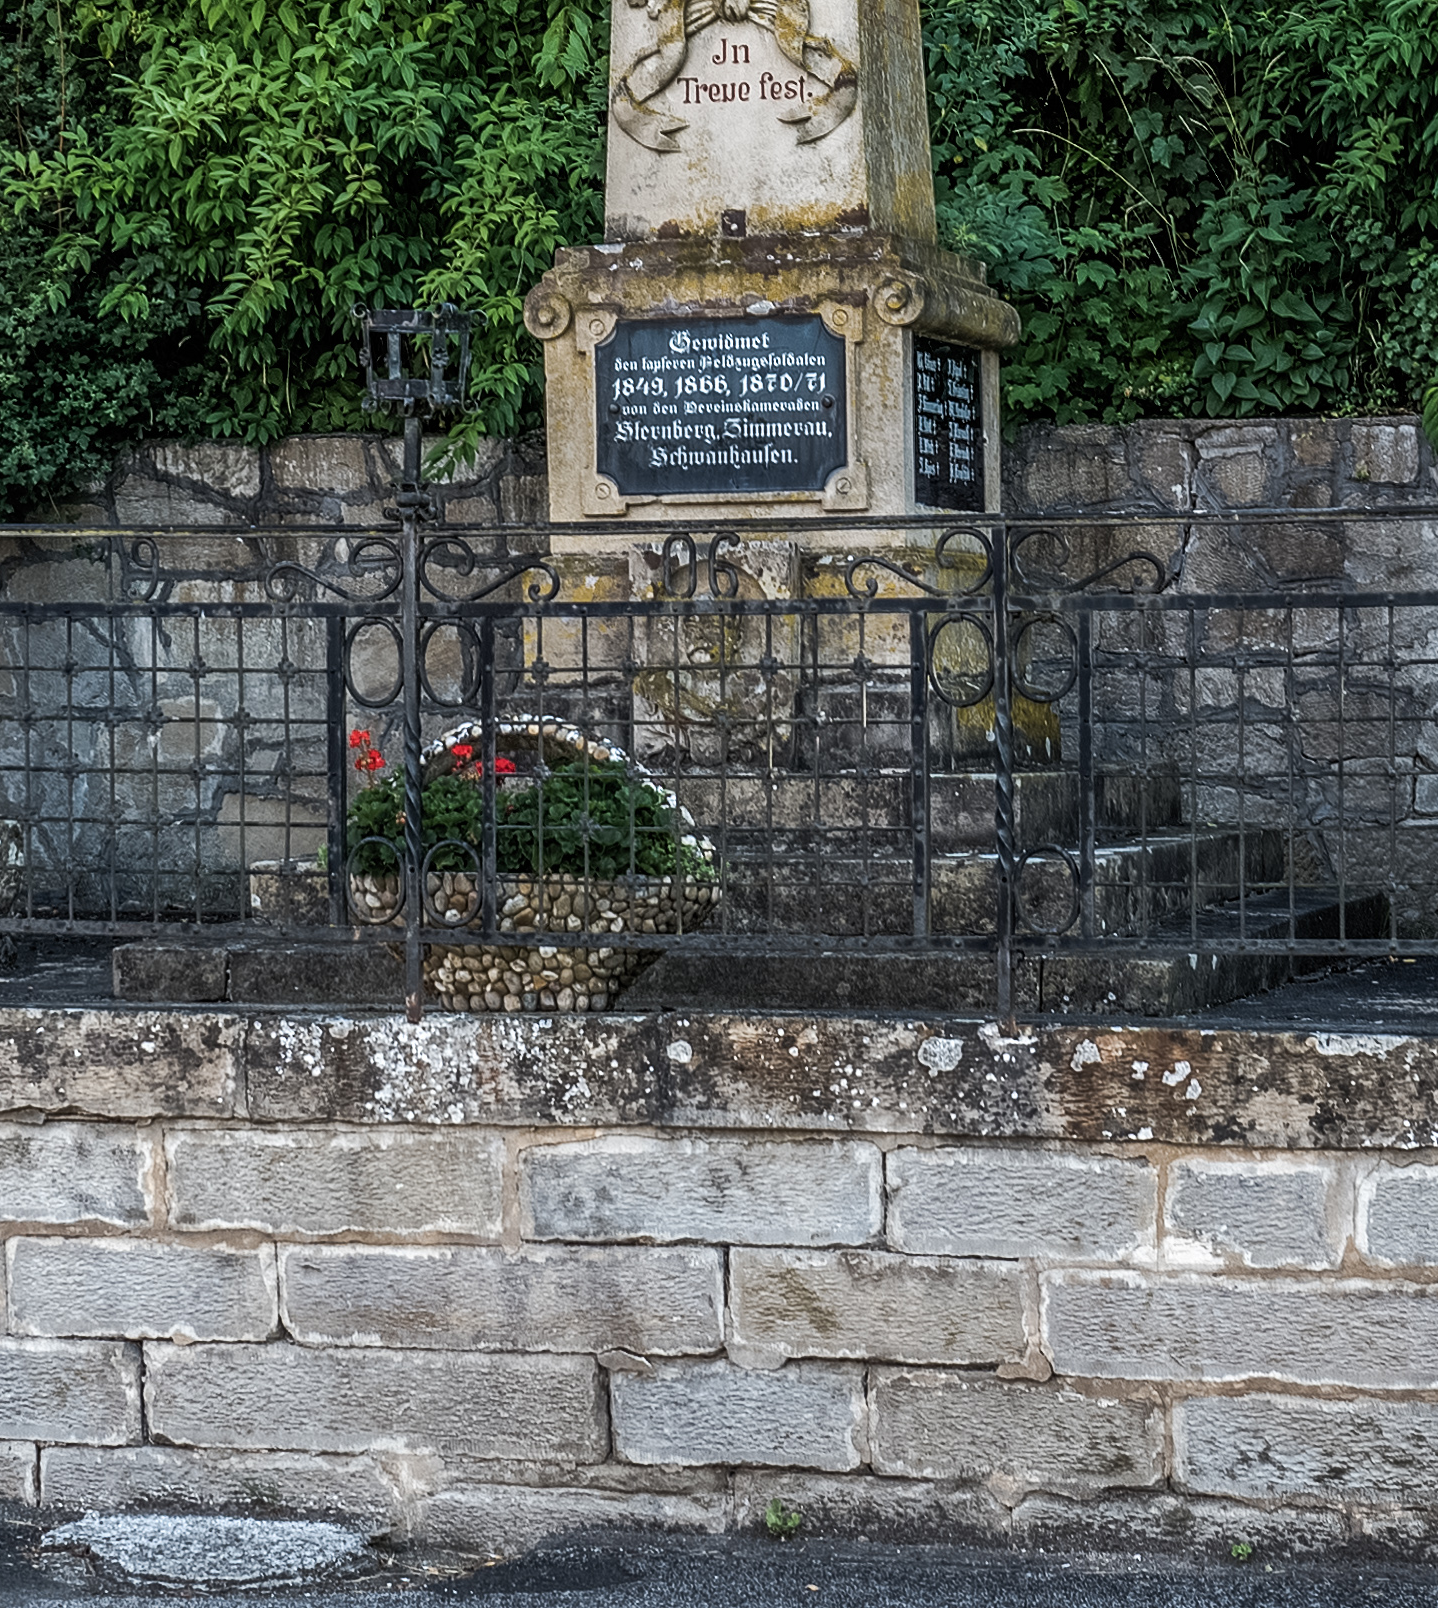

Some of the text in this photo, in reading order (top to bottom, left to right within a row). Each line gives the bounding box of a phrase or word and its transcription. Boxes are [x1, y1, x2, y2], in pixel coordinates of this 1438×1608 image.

[677, 72, 813, 104] Treue fest.
[669, 330, 770, 354] Gewidmet
[614, 357, 637, 372] den
[642, 355, 695, 374] tapferen
[612, 372, 827, 400] 1849, 1866, 1870/71
[622, 399, 819, 416] von den Vereinskameraden
[722, 417, 833, 439] Zimmerau,
[648, 444, 798, 469] Schwanhausen.
